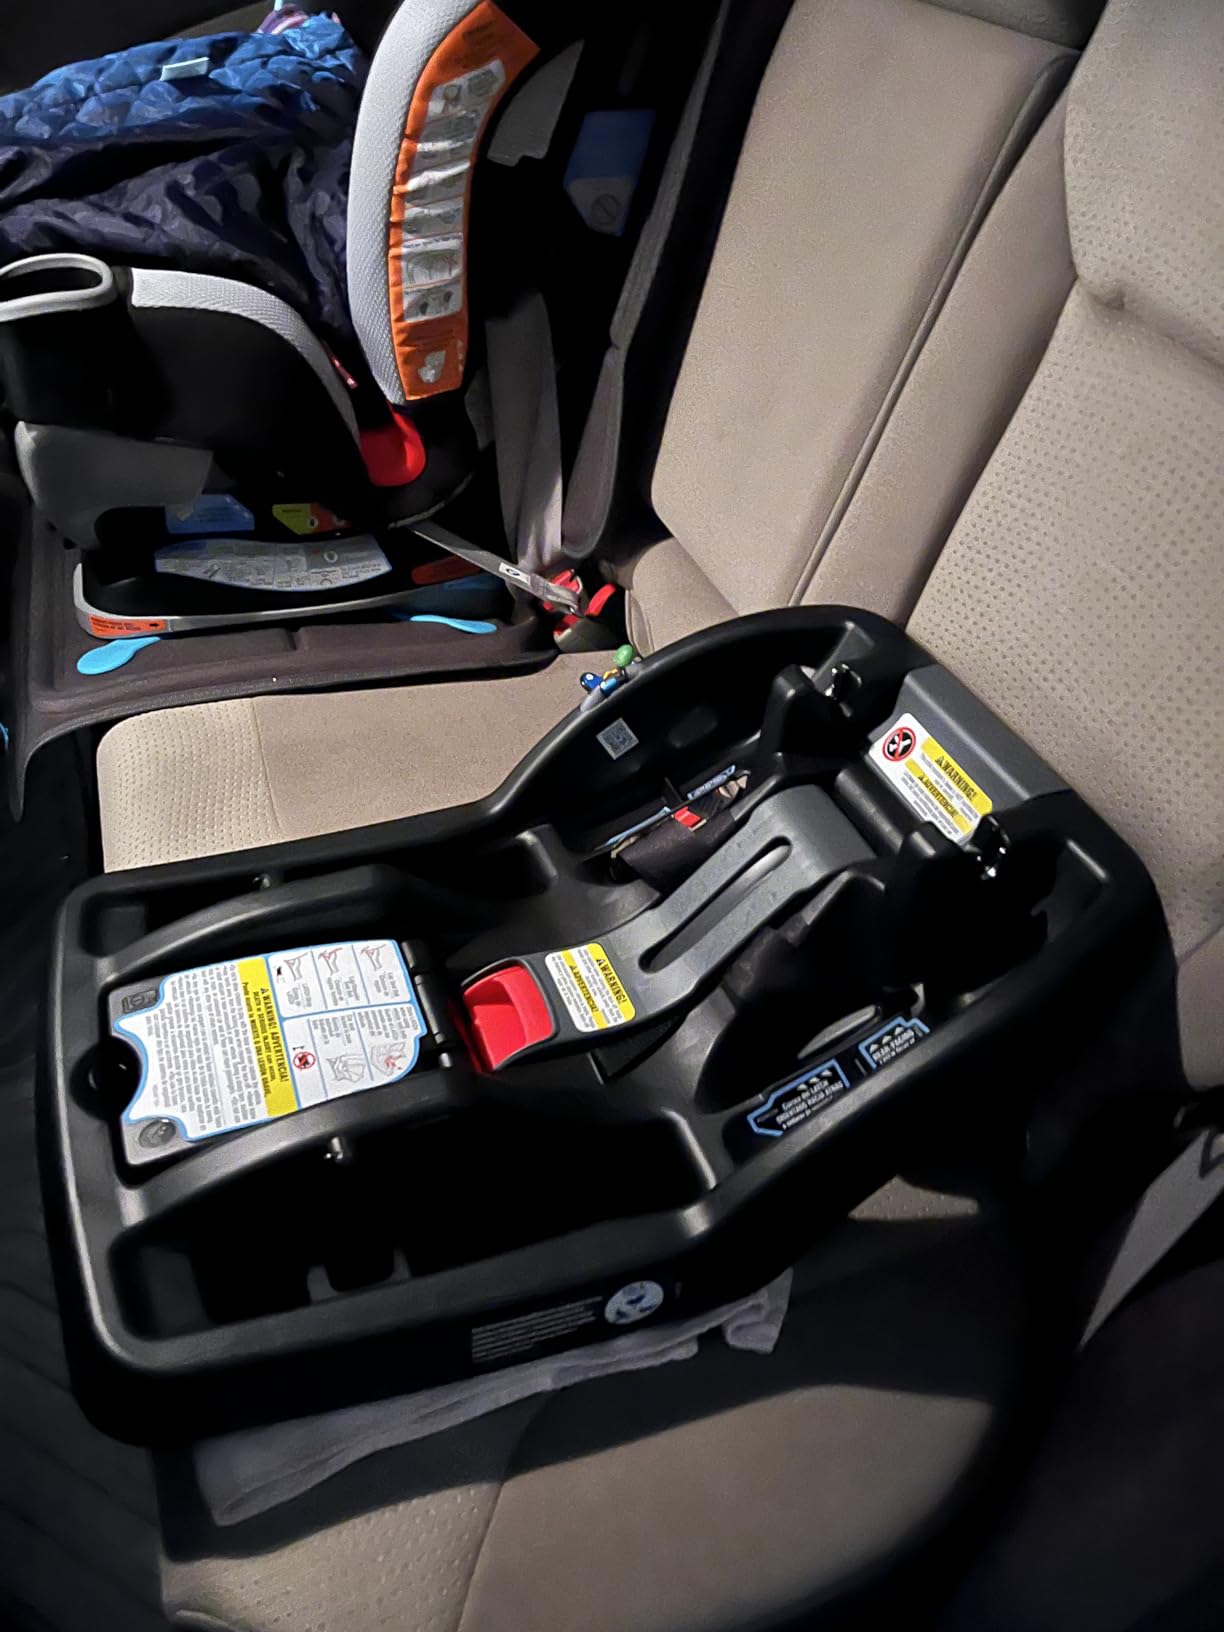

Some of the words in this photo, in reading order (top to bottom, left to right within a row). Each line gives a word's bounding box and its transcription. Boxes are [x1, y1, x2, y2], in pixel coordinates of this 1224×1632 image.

[939, 762, 977, 800] WARNING!
[599, 964, 628, 1004] WARNING!
[262, 994, 277, 1029] WARNING!
[270, 1030, 289, 1082] ADVERTENCIA!
